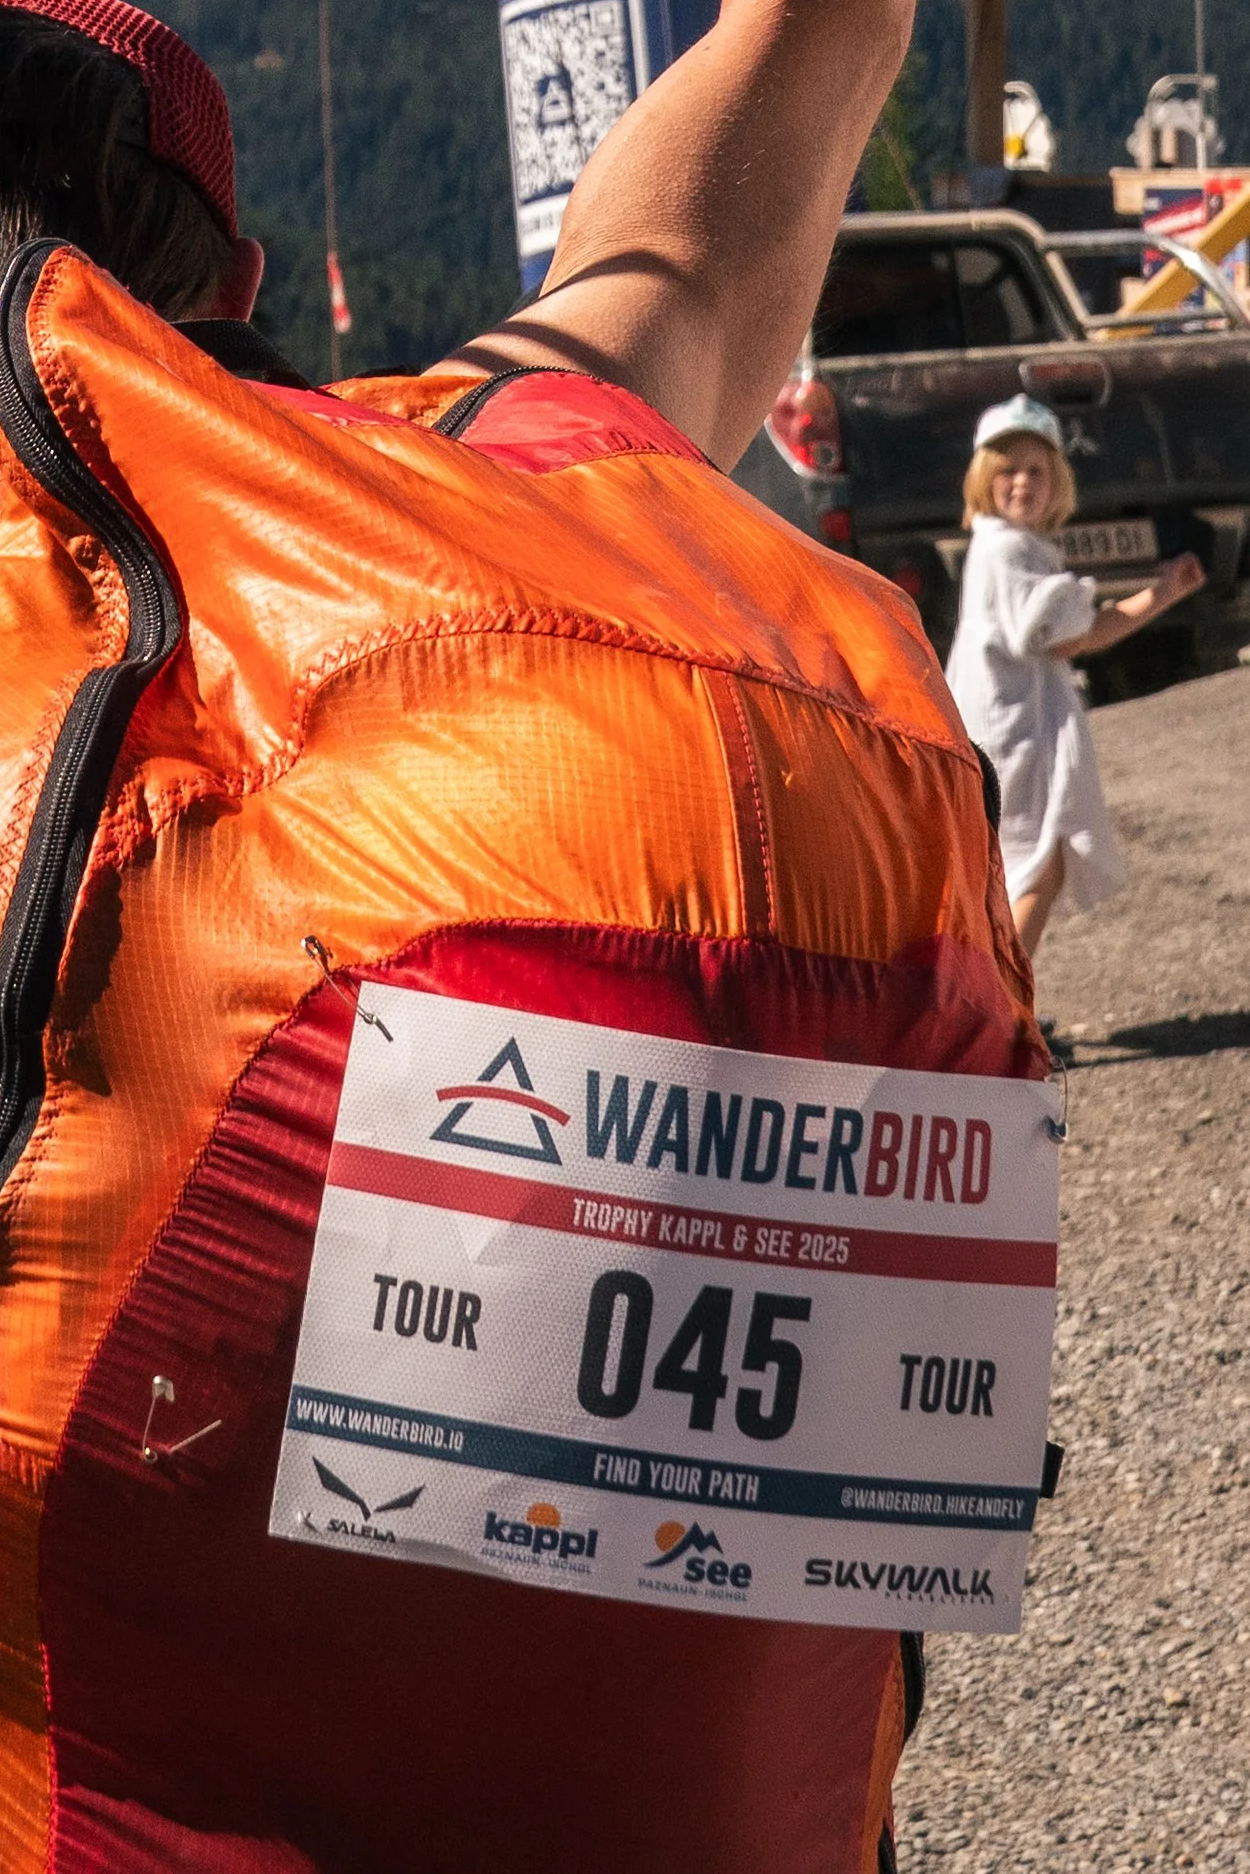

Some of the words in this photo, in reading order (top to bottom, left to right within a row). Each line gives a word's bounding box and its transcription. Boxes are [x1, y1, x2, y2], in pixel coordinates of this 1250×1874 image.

[585, 1069, 992, 1205] WANDERBIRD
[572, 1197, 654, 1240] TROPHY
[658, 1214, 726, 1250] KAPPL
[732, 1220, 750, 1251] &
[754, 1225, 793, 1259] SEE
[798, 1231, 851, 1264] 2025
[372, 1273, 482, 1351] TOUR
[576, 1269, 813, 1441] 045
[898, 1352, 998, 1417] TOUR
[296, 1397, 464, 1453] WWW.WANDERBIRD.IO
[593, 1452, 642, 1487] FIND
[649, 1461, 701, 1496] YOUR
[707, 1471, 760, 1504] PATH
[840, 1486, 1025, 1521] @WANDERBIRD.HIKEANDFLY
[327, 1518, 397, 1544] SALEWA
[484, 1510, 599, 1560] kappl
[684, 1556, 753, 1589] see
[804, 1557, 995, 1597] SKYWALK
